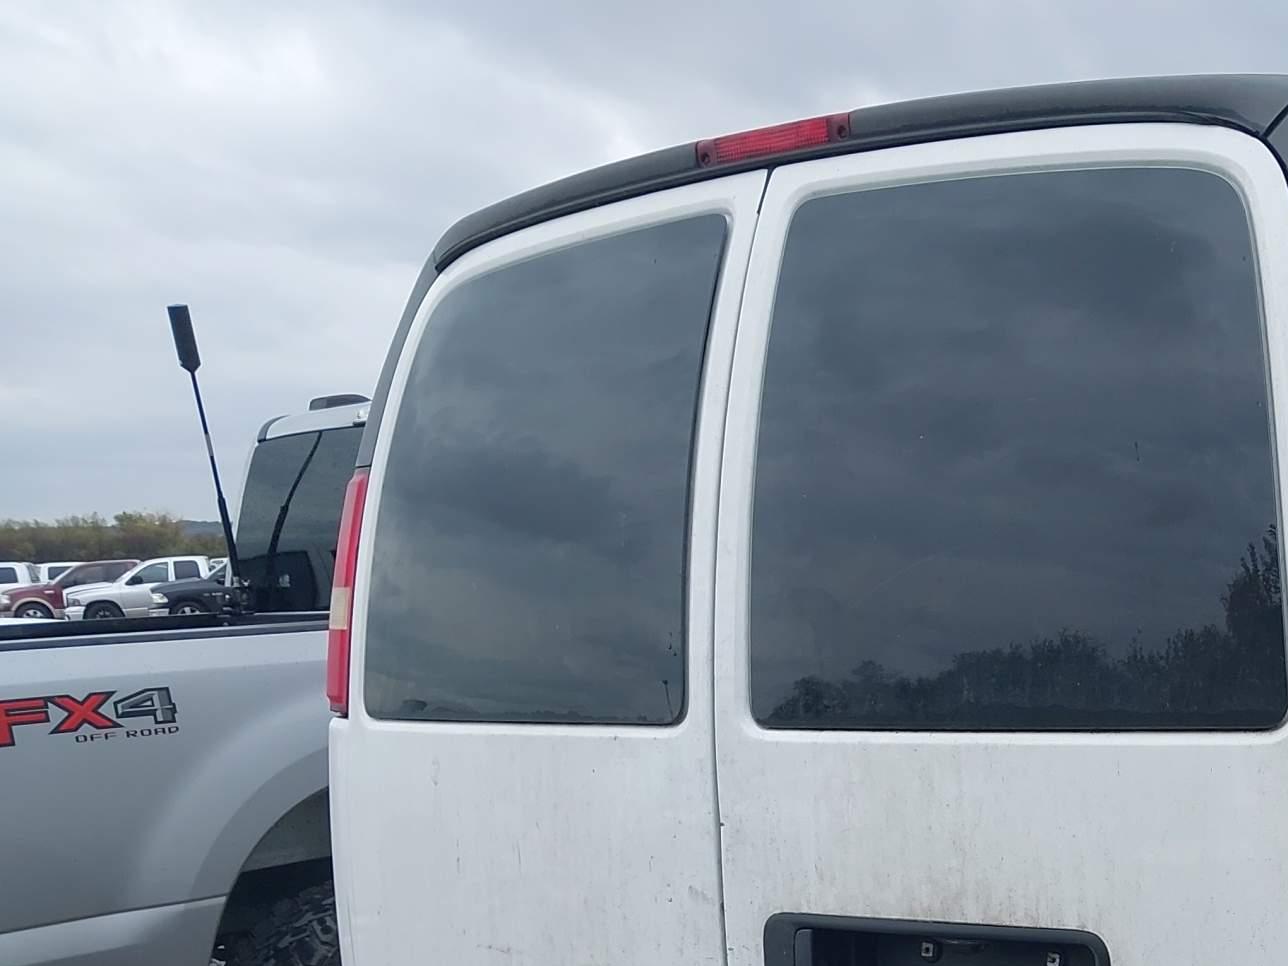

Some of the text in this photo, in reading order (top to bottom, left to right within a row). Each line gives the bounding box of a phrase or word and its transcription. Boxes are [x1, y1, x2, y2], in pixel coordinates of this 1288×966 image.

[0, 687, 178, 748] FX4
[75, 726, 180, 743] OFF ROAD
